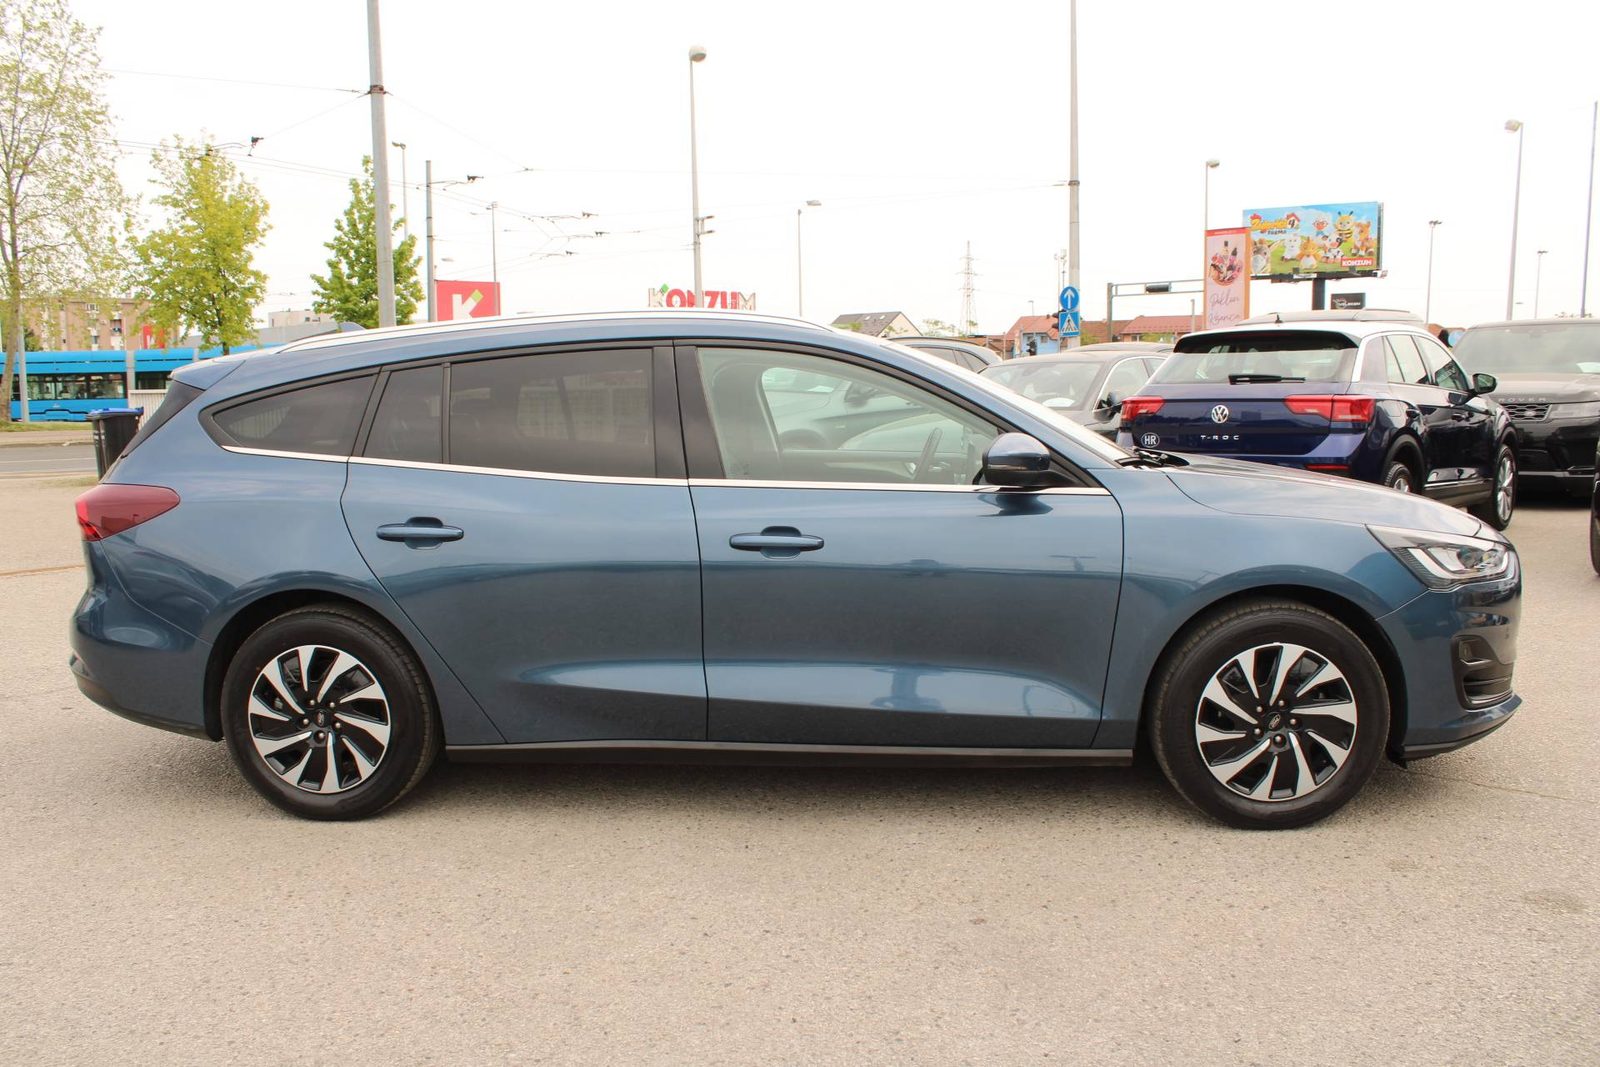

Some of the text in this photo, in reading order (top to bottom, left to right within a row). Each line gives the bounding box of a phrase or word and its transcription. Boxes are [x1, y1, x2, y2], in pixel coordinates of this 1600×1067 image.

[1342, 259, 1372, 267] KONZUM
[452, 289, 484, 320] K
[648, 284, 756, 310] KONZUM
[1144, 435, 1157, 445] HR
